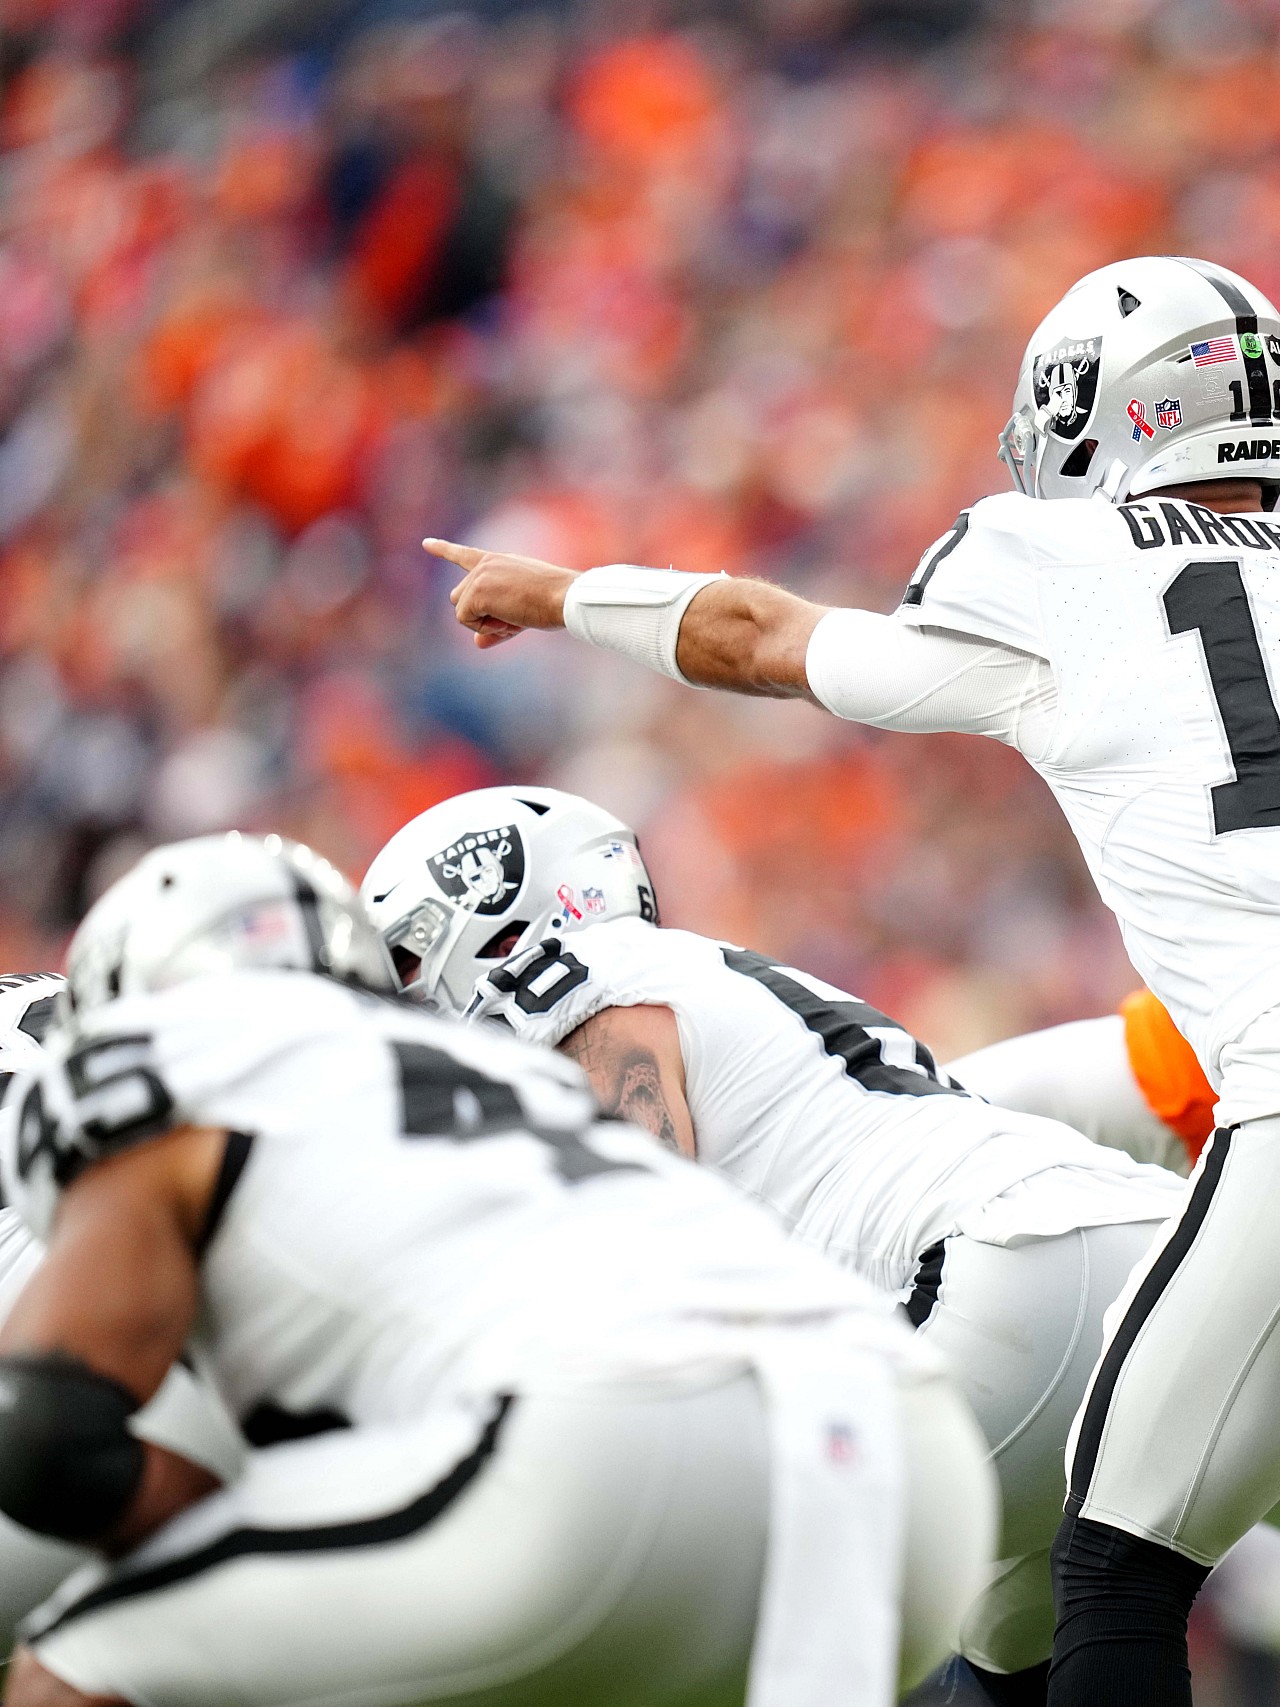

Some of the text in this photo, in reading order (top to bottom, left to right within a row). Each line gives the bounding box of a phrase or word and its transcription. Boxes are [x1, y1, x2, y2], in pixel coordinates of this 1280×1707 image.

[1158, 410, 1181, 427] NFL
[433, 827, 511, 866] RAIDERS
[470, 937, 589, 1024] 8
[17, 1033, 174, 1185] 45
